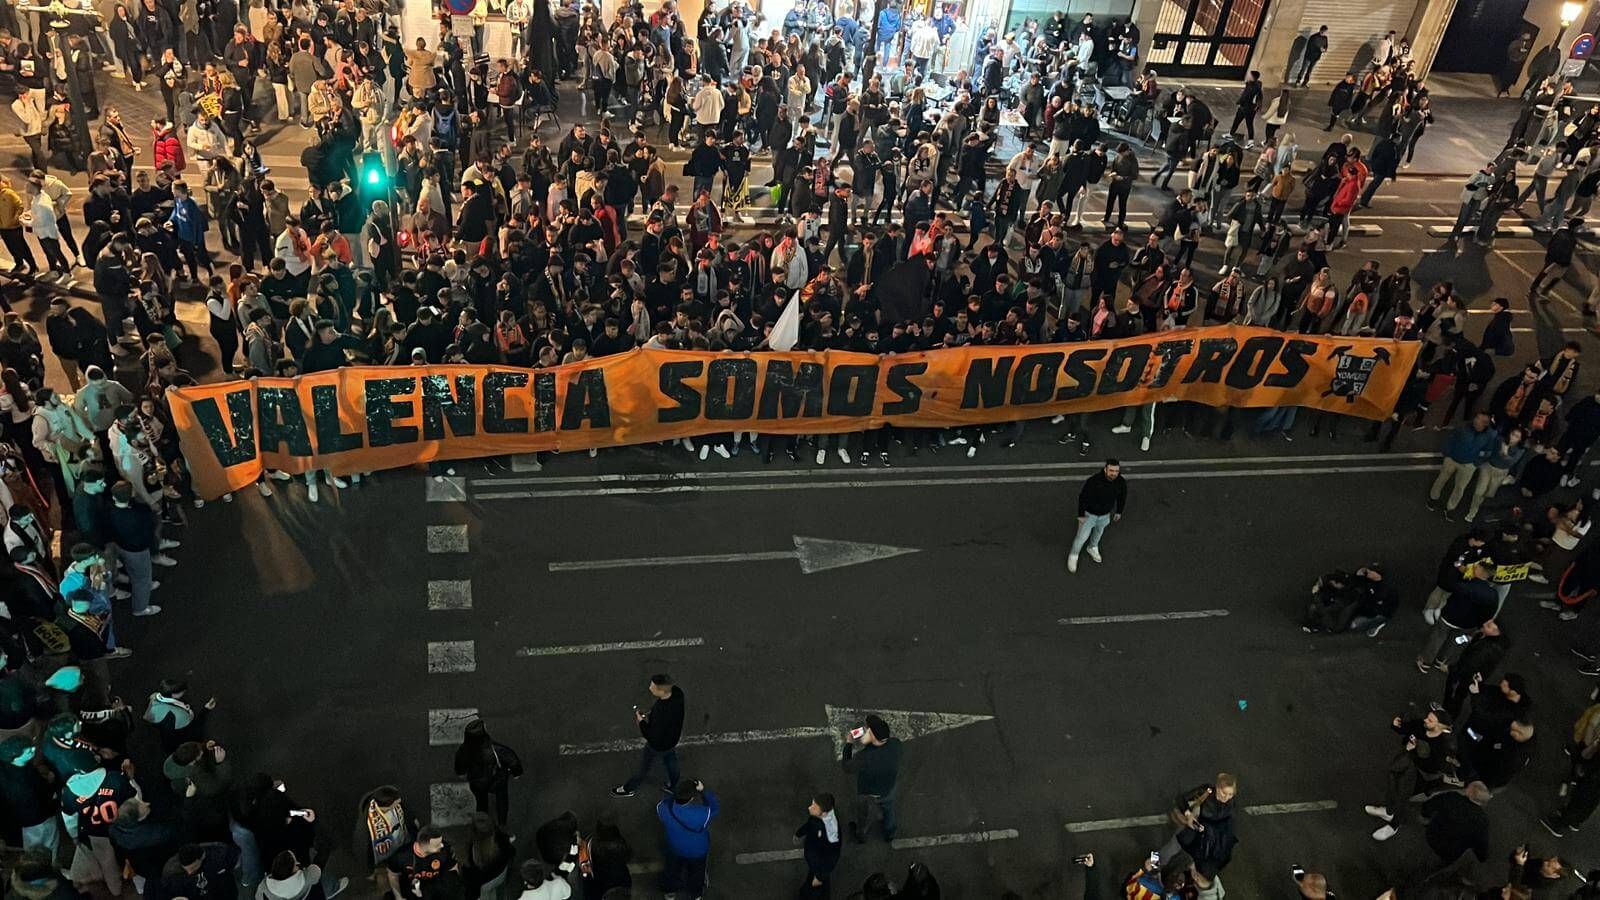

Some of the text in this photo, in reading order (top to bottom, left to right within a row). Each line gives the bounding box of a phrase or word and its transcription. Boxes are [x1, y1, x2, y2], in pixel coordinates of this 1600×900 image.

[192, 336, 1317, 467] VALENCIA SOMOS NOSOTROS
[82, 801, 119, 825] 20
